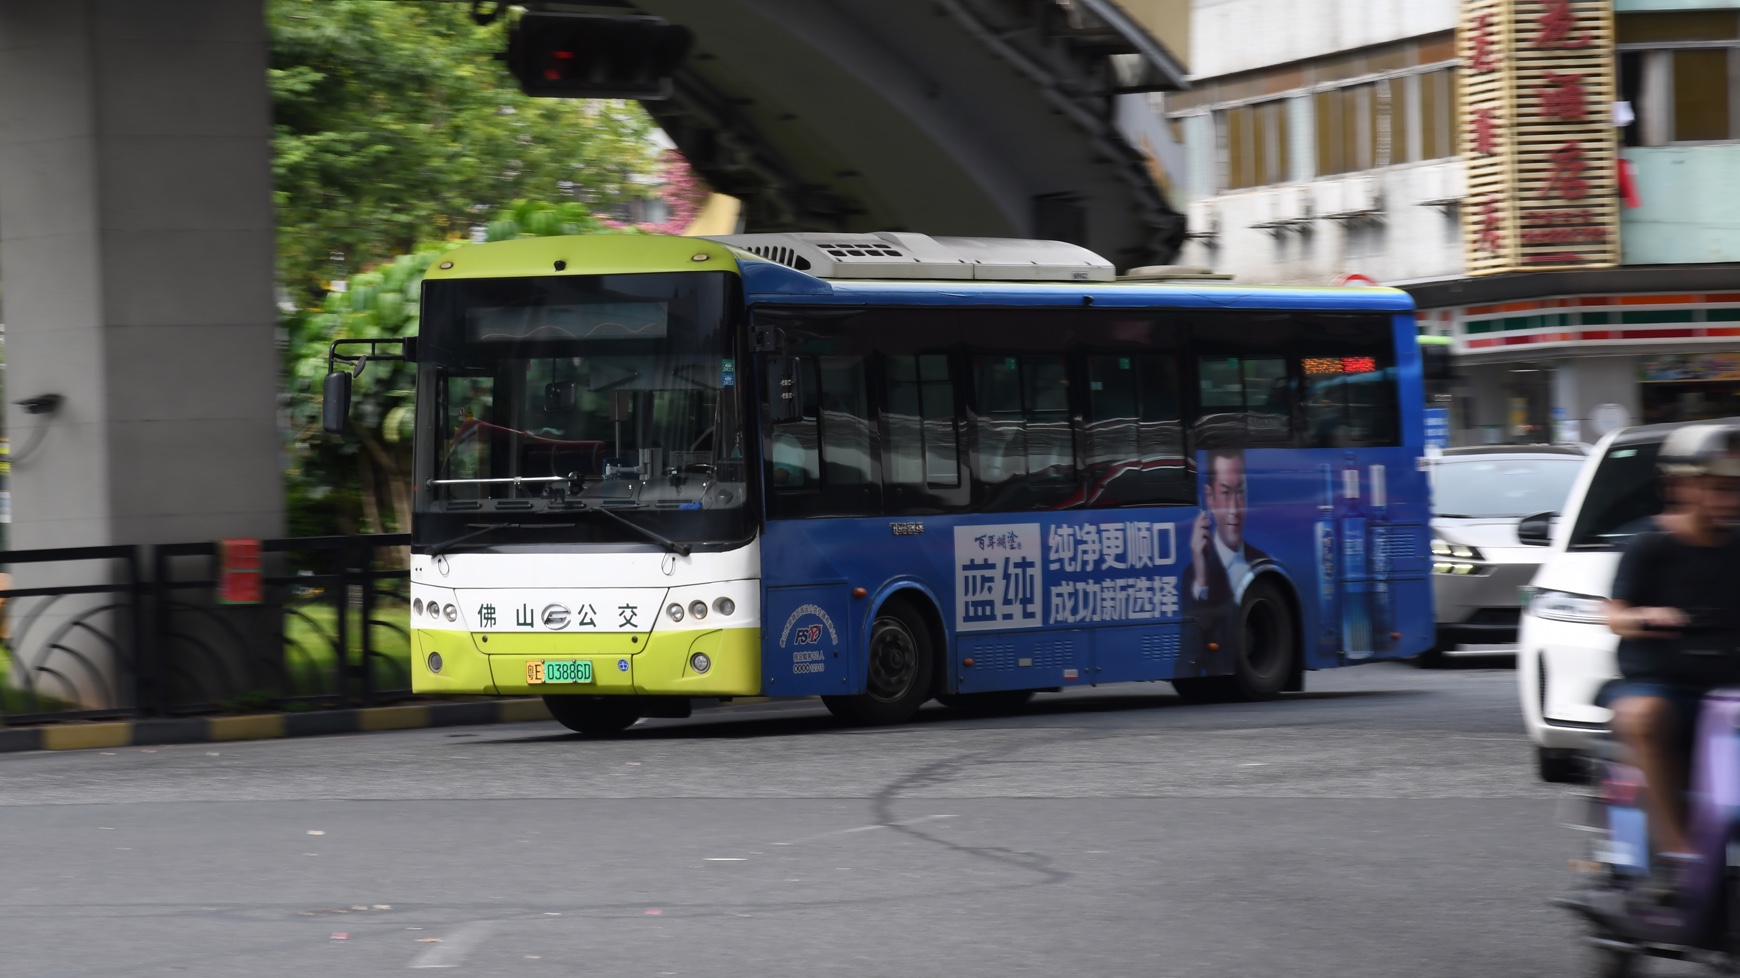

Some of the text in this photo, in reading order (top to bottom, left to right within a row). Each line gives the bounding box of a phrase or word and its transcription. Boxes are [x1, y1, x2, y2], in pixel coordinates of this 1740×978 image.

[1048, 521, 1177, 572] 纯净更顺口
[962, 556, 1037, 623] 蓝纯
[1049, 576, 1179, 624] 成功新选择
